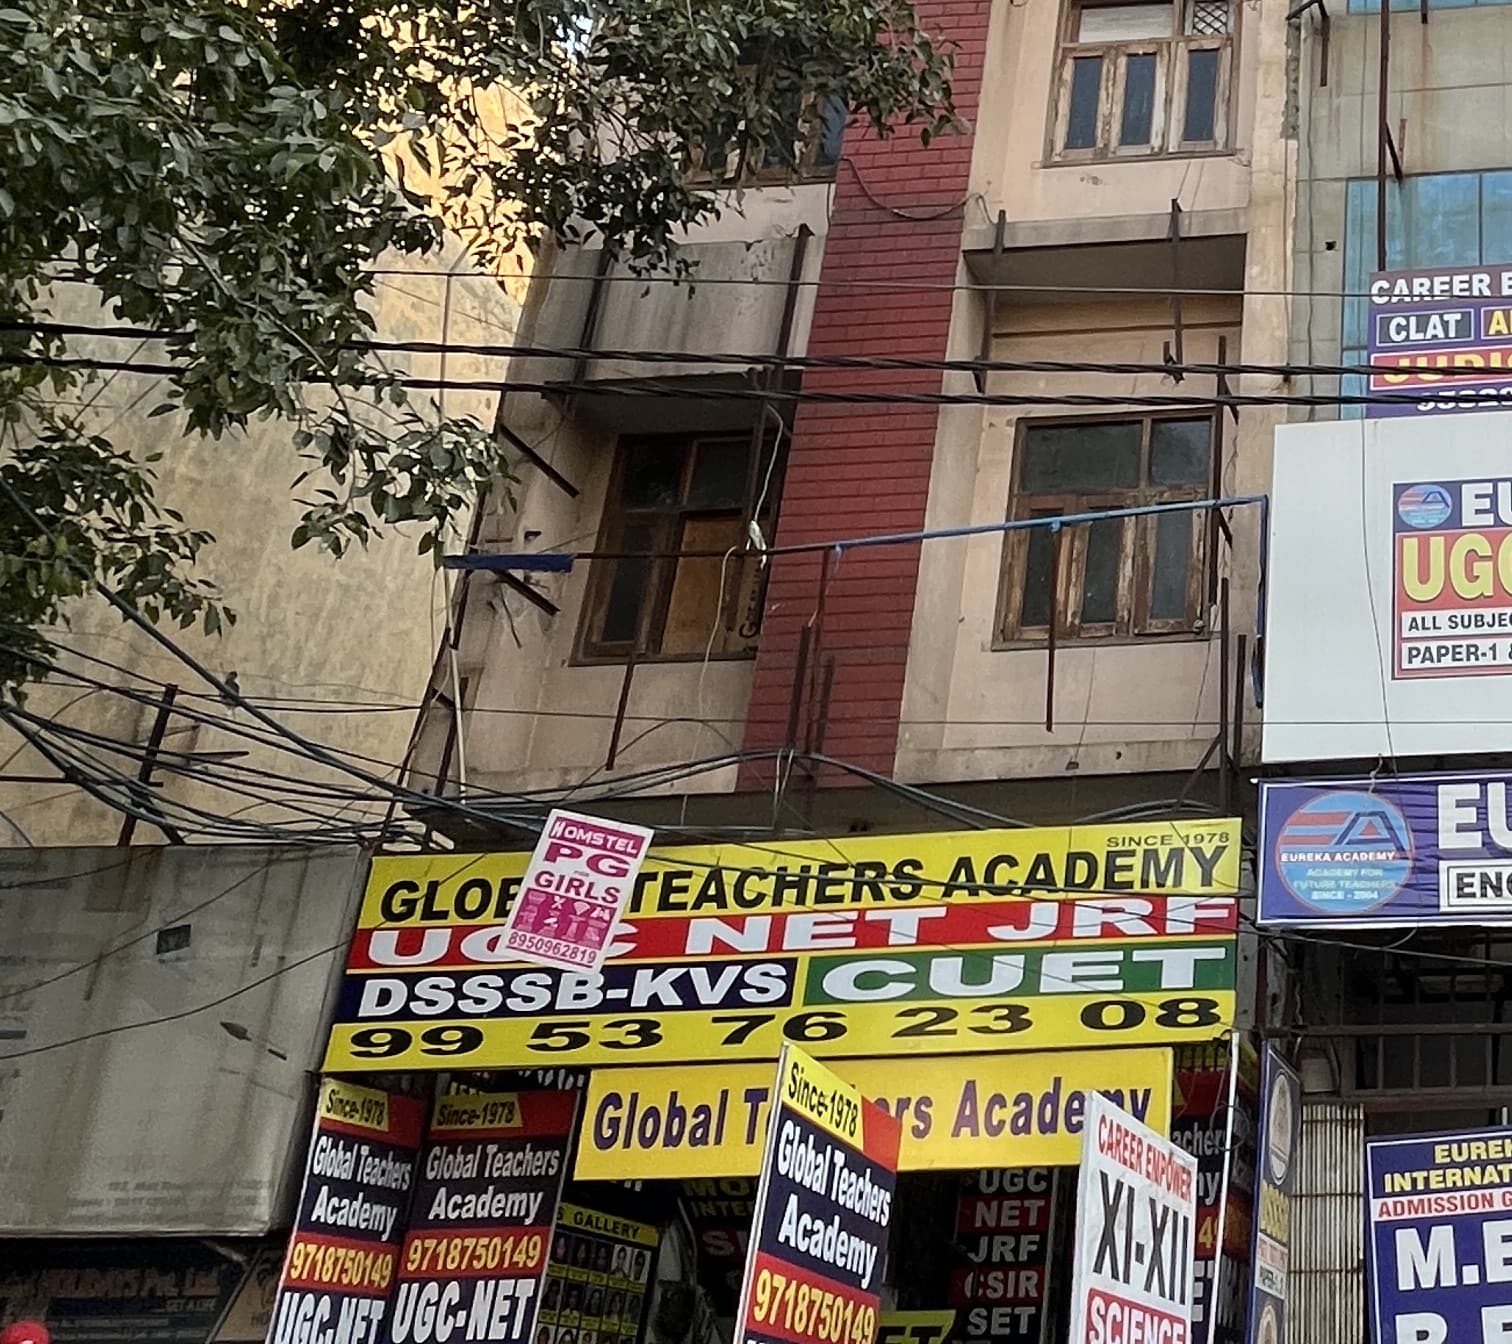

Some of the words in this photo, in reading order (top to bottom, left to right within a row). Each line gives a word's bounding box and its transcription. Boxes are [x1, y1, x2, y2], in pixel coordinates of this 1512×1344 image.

[1370, 269, 1491, 305] CAREER
[1388, 313, 1462, 341] CLAT
[1408, 613, 1443, 633] ALL
[1407, 643, 1502, 666] PAPER-1
[551, 821, 638, 854] HOMSTEL
[1106, 834, 1173, 847] SINCE
[1183, 832, 1231, 846] 1978
[542, 843, 631, 878] PG
[1280, 852, 1332, 862] EUREKA
[1334, 852, 1395, 862] ACADEMY
[534, 870, 621, 904] GIRLS
[630, 856, 925, 912] TEACHERS
[943, 845, 1227, 898] ACADEMY
[685, 906, 948, 955] NET
[986, 897, 1235, 941] JRF
[508, 931, 597, 965] 8950962819
[822, 947, 1226, 1002] CUET
[349, 1025, 484, 1058] 99
[526, 1018, 663, 1052] 53
[711, 1012, 848, 1046] 76
[891, 1004, 1033, 1038] 23
[1080, 997, 1221, 1032] 08
[436, 1102, 516, 1127] Since-1978
[593, 1092, 724, 1151] Global
[426, 1144, 483, 1180] Global
[483, 1142, 560, 1178] Teachers
[1098, 1113, 1144, 1176] CAREER
[311, 1135, 358, 1180] Global
[357, 1145, 412, 1192] Teachers
[777, 1119, 832, 1194] Global
[830, 1151, 892, 1228] Teachers
[978, 1167, 1049, 1194] UGC
[311, 1185, 398, 1242] Academy
[428, 1187, 544, 1225] Academy
[974, 1199, 1046, 1228] NET
[1377, 1193, 1495, 1218] ADMISSION
[573, 1210, 640, 1239] GALLERY
[778, 1192, 879, 1291] Academy
[290, 1242, 393, 1288] 9718750149
[406, 1235, 542, 1273] 9718750149
[966, 1235, 1041, 1263] JRF
[964, 1270, 1039, 1299] CSIR
[390, 1278, 536, 1344] UGC-NET
[966, 1307, 1037, 1336] SET
